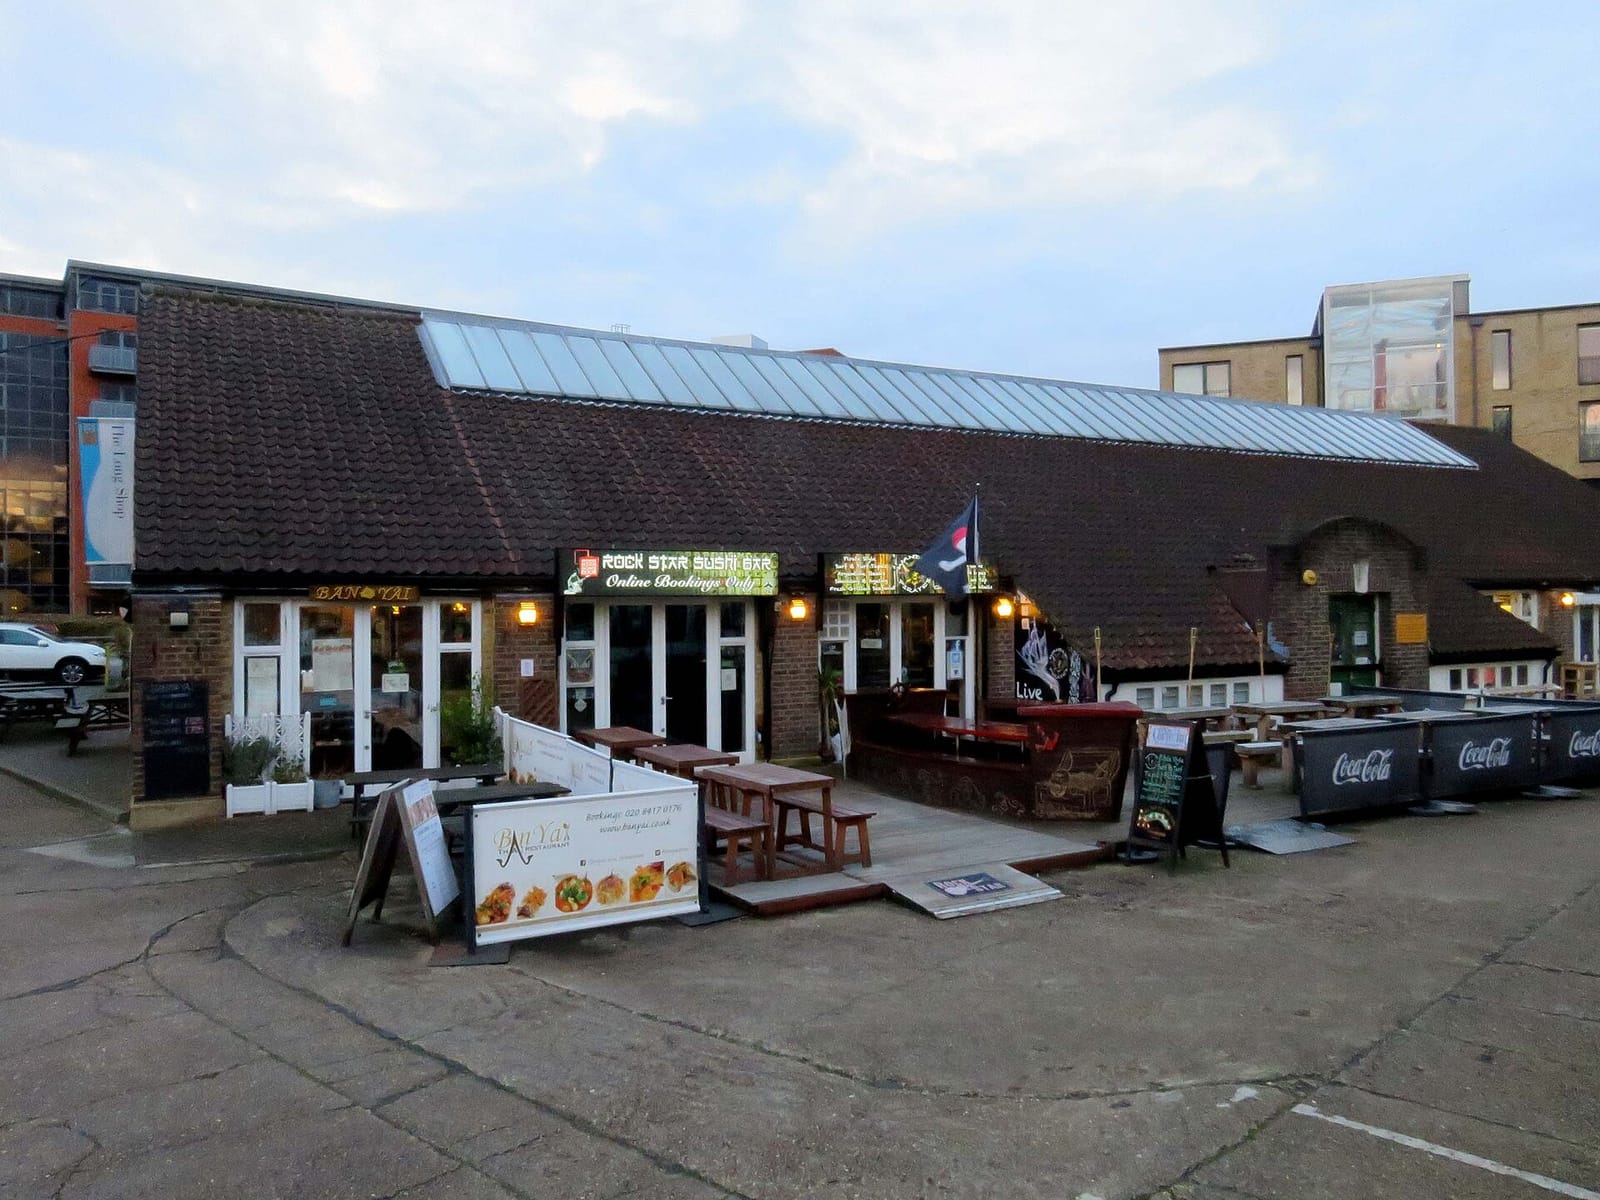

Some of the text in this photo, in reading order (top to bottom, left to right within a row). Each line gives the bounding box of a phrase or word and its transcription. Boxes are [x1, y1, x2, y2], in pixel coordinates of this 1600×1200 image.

[112, 488, 129, 519] Shop
[602, 553, 644, 570] ROCK
[649, 554, 689, 572] STAR
[742, 557, 771, 571] BAR
[606, 574, 755, 592] Online Bookings Only
[316, 586, 415, 600] BAN YAI
[1016, 681, 1043, 700] Live
[1332, 749, 1393, 785] Coca-Cola
